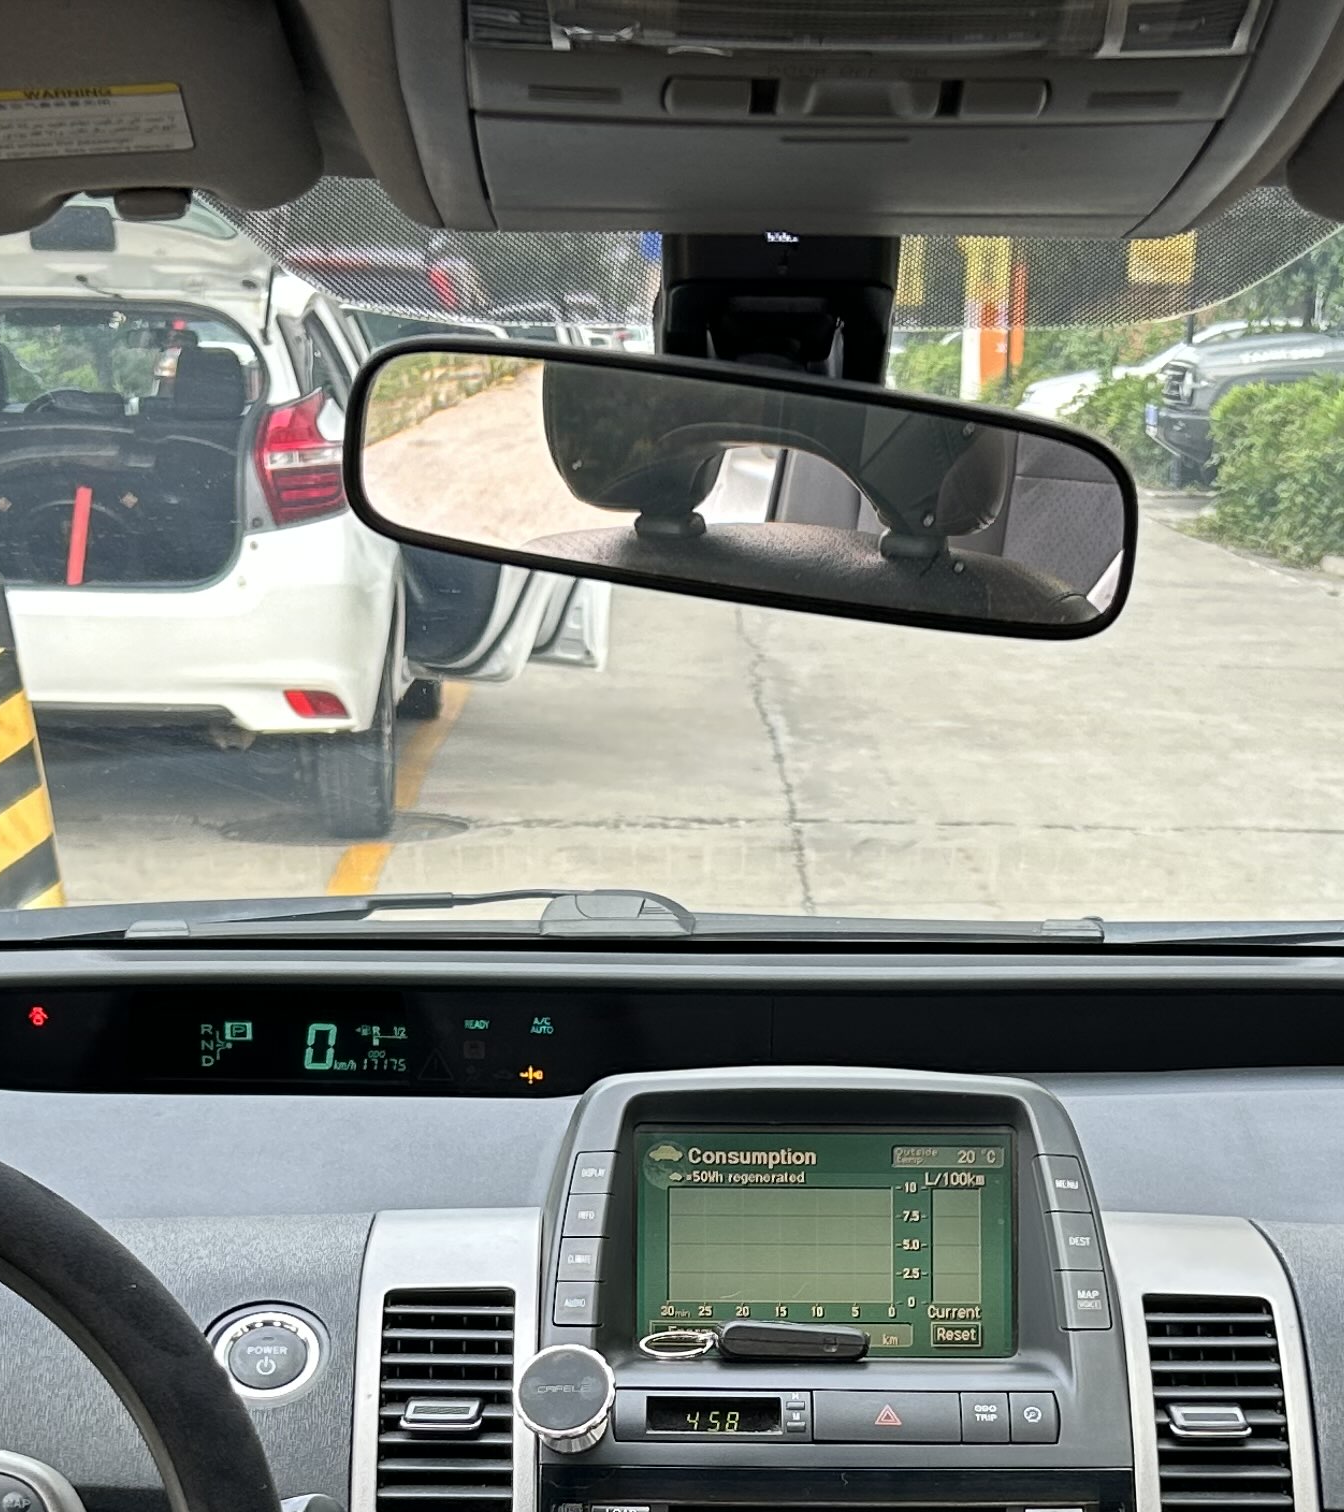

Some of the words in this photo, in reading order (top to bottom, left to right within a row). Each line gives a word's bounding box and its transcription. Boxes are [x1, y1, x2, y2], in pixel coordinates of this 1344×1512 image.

[22, 87, 112, 100] WARNING
[464, 1019, 490, 1030] READY
[532, 1017, 551, 1025] A/C
[200, 1023, 213, 1035] R
[530, 1025, 554, 1034] AUTO
[201, 1040, 214, 1051] N
[304, 1022, 337, 1070] 0
[333, 1059, 357, 1071] km/h
[201, 1056, 215, 1067] D
[687, 1147, 817, 1169] Consumption
[957, 1150, 976, 1164] 20
[581, 1168, 606, 1178] DISPLAY
[728, 1170, 806, 1185] regenerated
[924, 1171, 986, 1187] L/100km
[1054, 1179, 1079, 1190] MENU
[903, 1181, 917, 1193] 10
[902, 1210, 920, 1222] 7.5
[902, 1239, 920, 1250] 5.0
[1068, 1236, 1092, 1247] DEST
[902, 1268, 920, 1279] 2.5
[1077, 1289, 1100, 1300] MAP
[564, 1298, 586, 1308] AUDIO
[907, 1296, 916, 1308] 0
[698, 1305, 713, 1317] 25
[735, 1305, 750, 1317] 20
[775, 1305, 788, 1317] 15
[811, 1305, 824, 1317] 10
[852, 1306, 860, 1318] 5
[888, 1306, 896, 1318] 0
[927, 1305, 981, 1320] Current
[937, 1327, 976, 1341] Reset
[882, 1334, 899, 1346] km
[247, 1346, 288, 1355] POWER
[537, 1384, 593, 1393] CAFELE
[975, 1413, 998, 1422] TRIP
